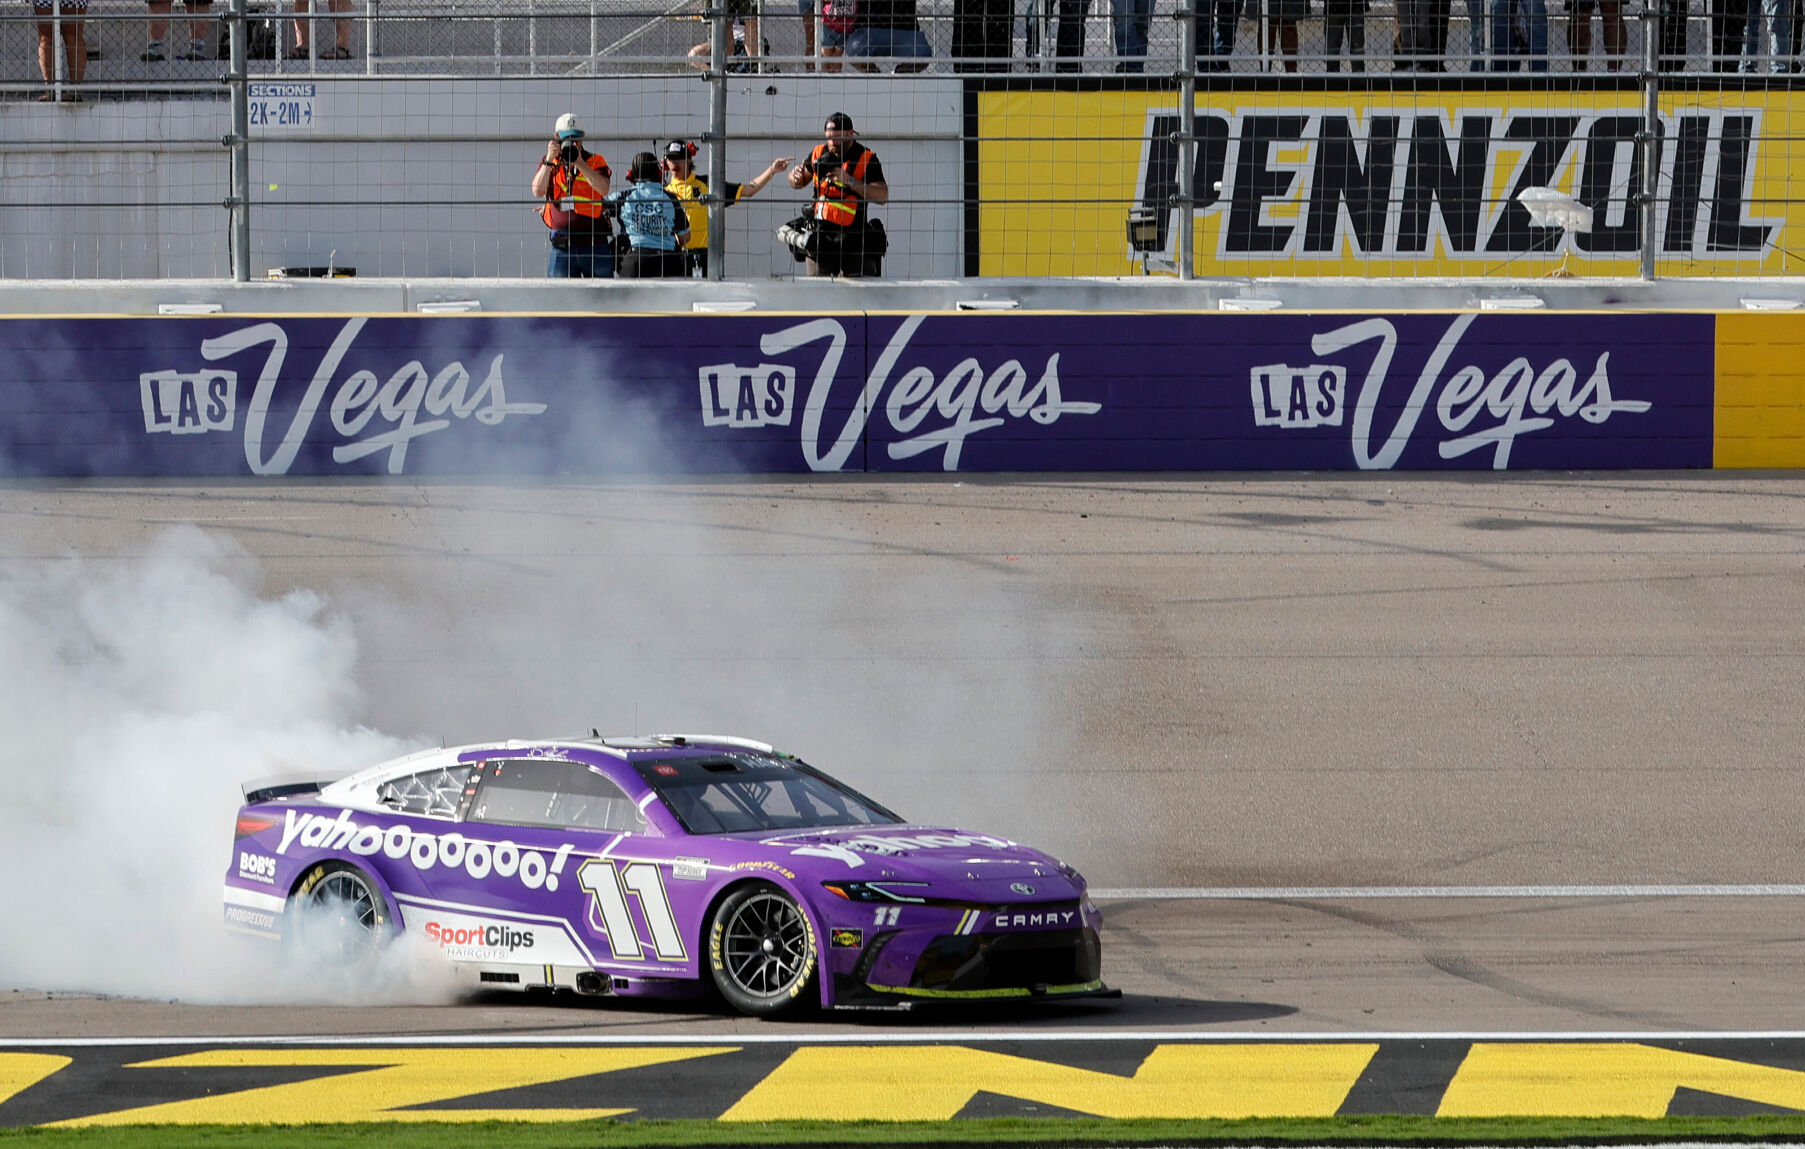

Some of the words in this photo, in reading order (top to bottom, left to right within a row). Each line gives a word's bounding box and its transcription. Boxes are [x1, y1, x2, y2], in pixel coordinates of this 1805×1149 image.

[250, 85, 312, 96] SECTIONS
[250, 102, 300, 125] 2K-2M
[1132, 109, 1782, 257] PENNZOIL
[635, 203, 663, 214] CSC
[145, 373, 232, 430] LAS
[201, 317, 547, 475] Vegas
[704, 366, 791, 425] LAS
[760, 315, 1101, 471] Vegas
[1255, 366, 1342, 425] LAS
[1311, 314, 1652, 470] Vegas
[239, 851, 276, 877] BOB'S
[577, 858, 689, 962] 11
[873, 906, 902, 926] 11
[995, 911, 1074, 927] CAMRY
[424, 922, 534, 952] SportClips
[711, 921, 724, 970] EAGLE
[447, 946, 505, 960] HAIRCUTS
